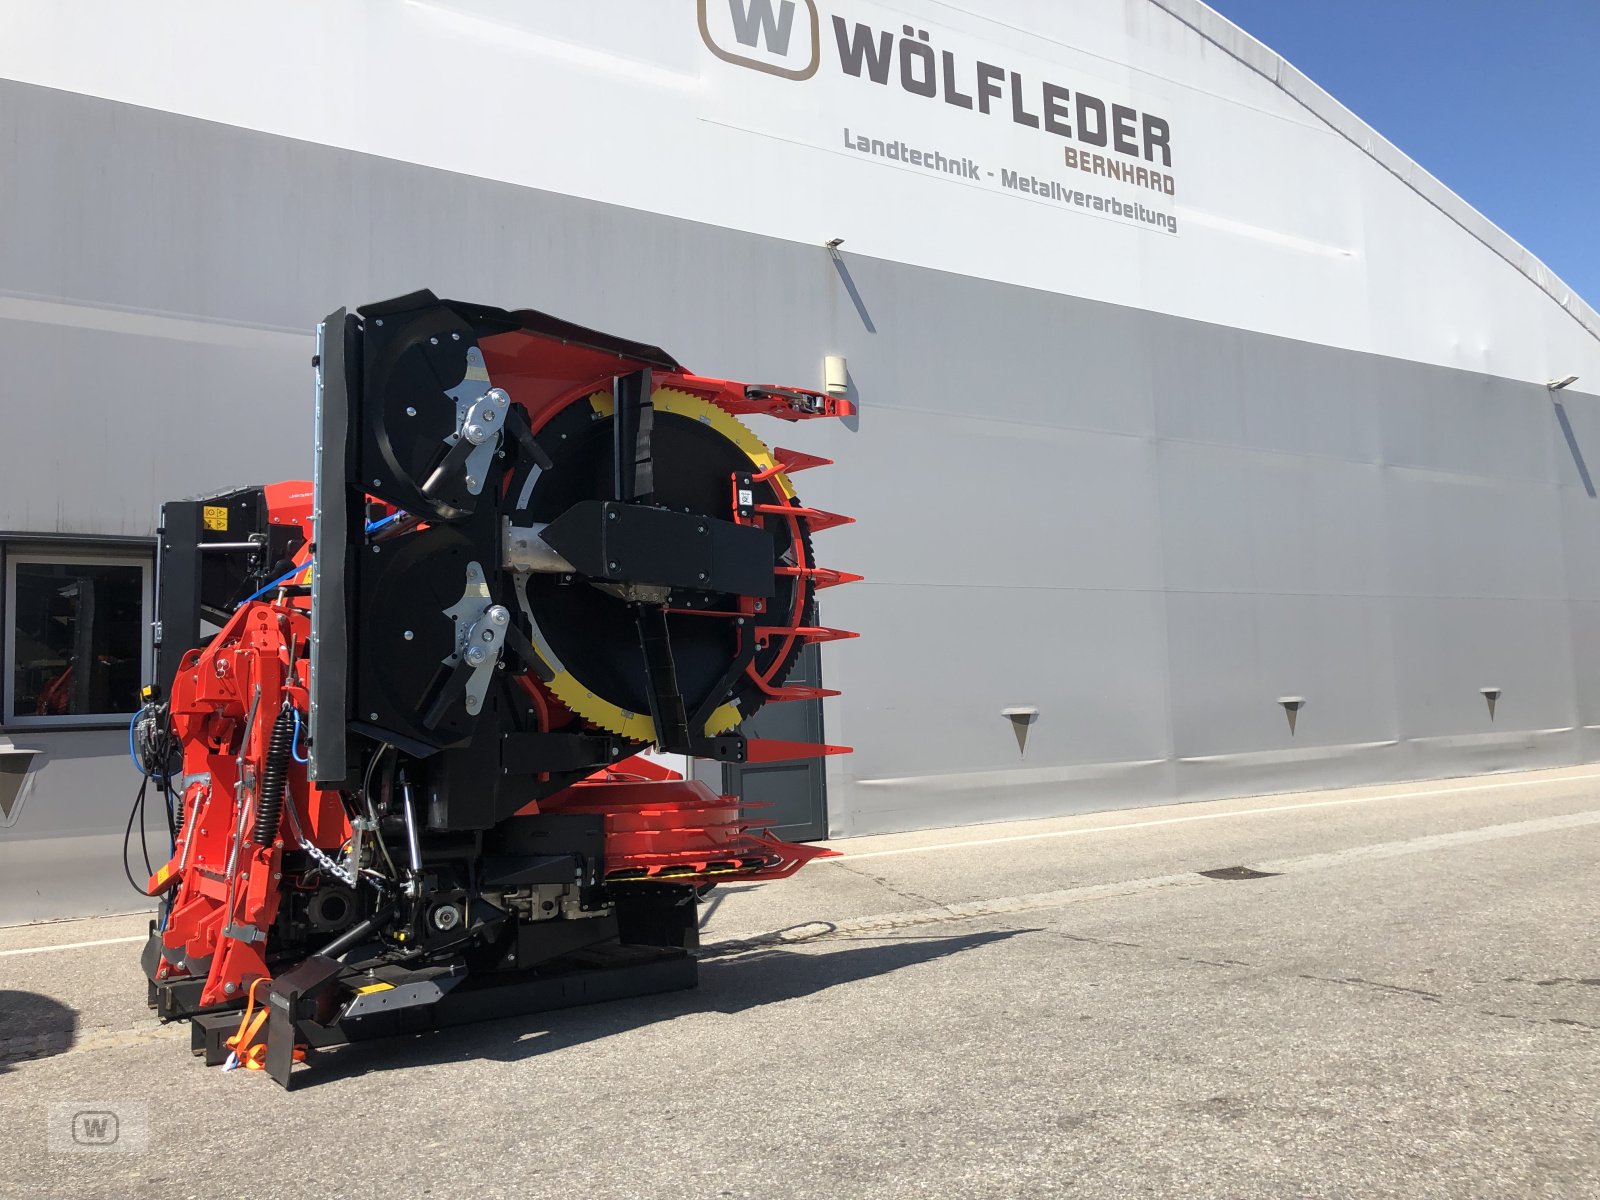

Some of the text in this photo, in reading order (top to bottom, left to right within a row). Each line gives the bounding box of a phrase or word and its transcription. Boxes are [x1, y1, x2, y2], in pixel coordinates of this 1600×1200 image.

[728, 0, 1172, 168] W WÖLFLEDER
[843, 127, 981, 181] Landtechnik
[1001, 168, 1178, 234] Metallverarbeitung
[1064, 146, 1175, 196] BERNHARD
